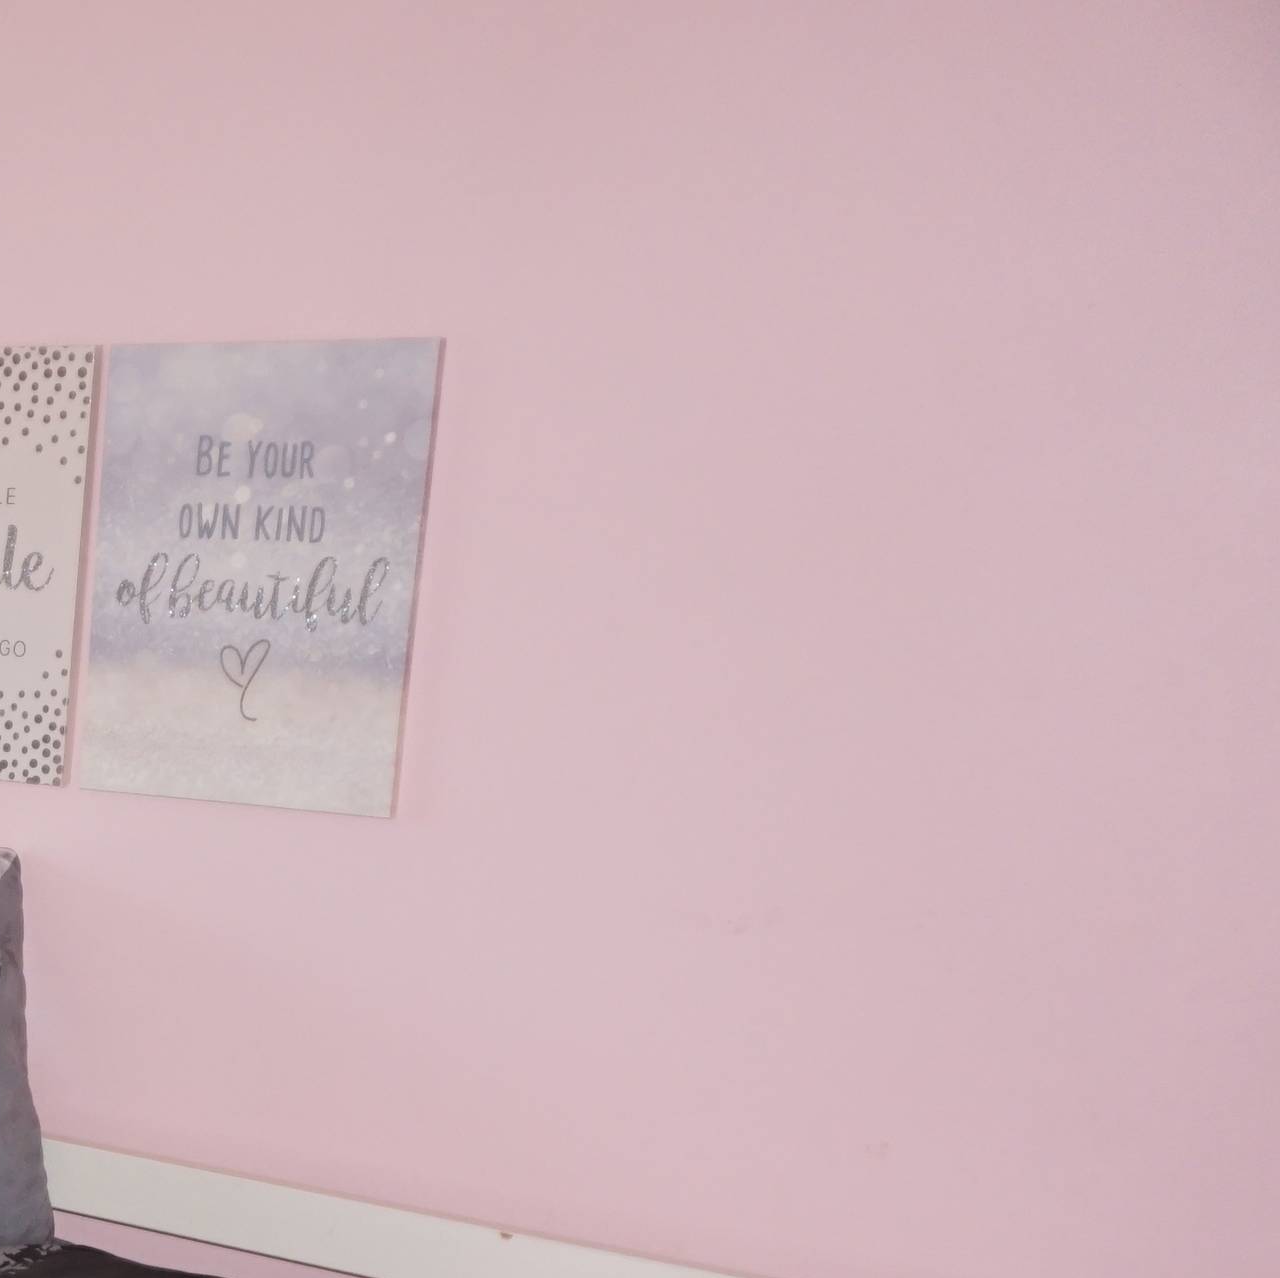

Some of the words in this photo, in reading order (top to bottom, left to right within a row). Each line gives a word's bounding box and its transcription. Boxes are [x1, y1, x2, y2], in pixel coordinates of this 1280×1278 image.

[196, 434, 232, 478] BE
[247, 440, 315, 480] YOUR
[178, 502, 240, 540] OWN
[254, 504, 326, 543] KIND
[116, 552, 169, 625] of
[168, 552, 391, 633] beautiful
[0, 639, 27, 658] GO
